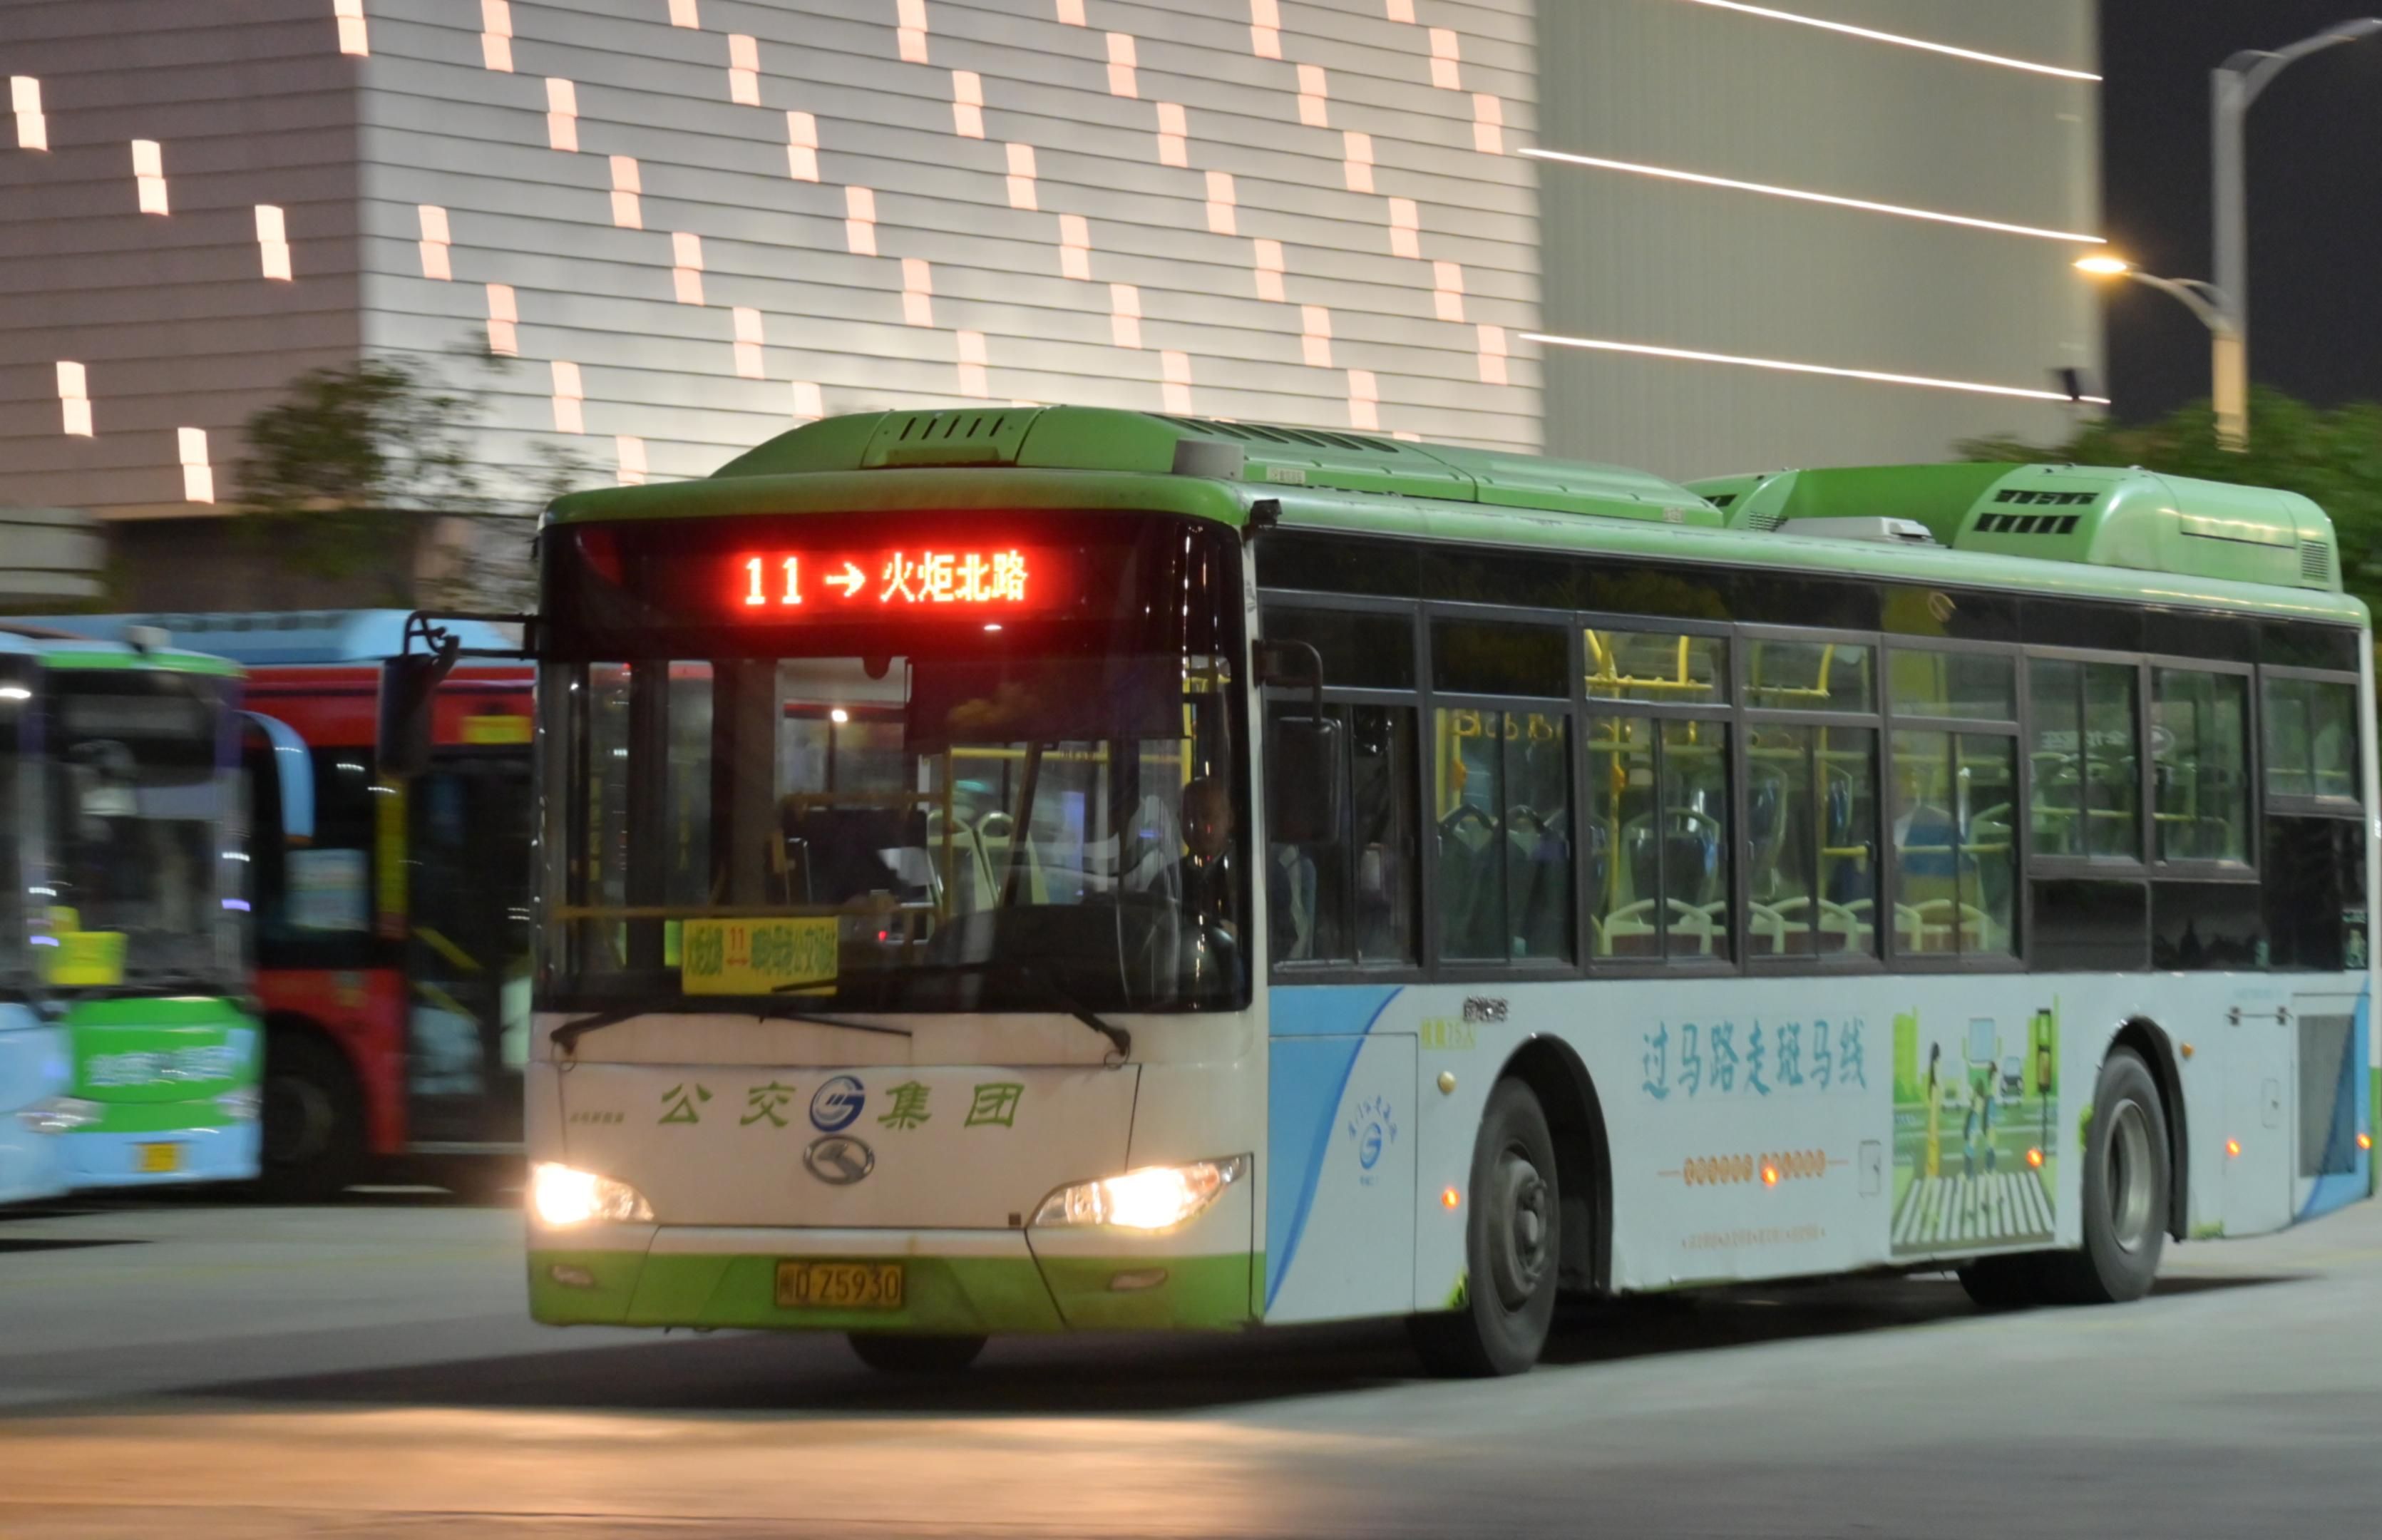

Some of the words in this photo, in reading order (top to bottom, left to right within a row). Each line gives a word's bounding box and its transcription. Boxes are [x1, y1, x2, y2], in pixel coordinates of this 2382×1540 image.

[745, 555, 802, 605] 11
[880, 549, 1029, 603] 火炬北路
[729, 927, 745, 952] 11
[1641, 1017, 1867, 1100] 过马路走斑马线
